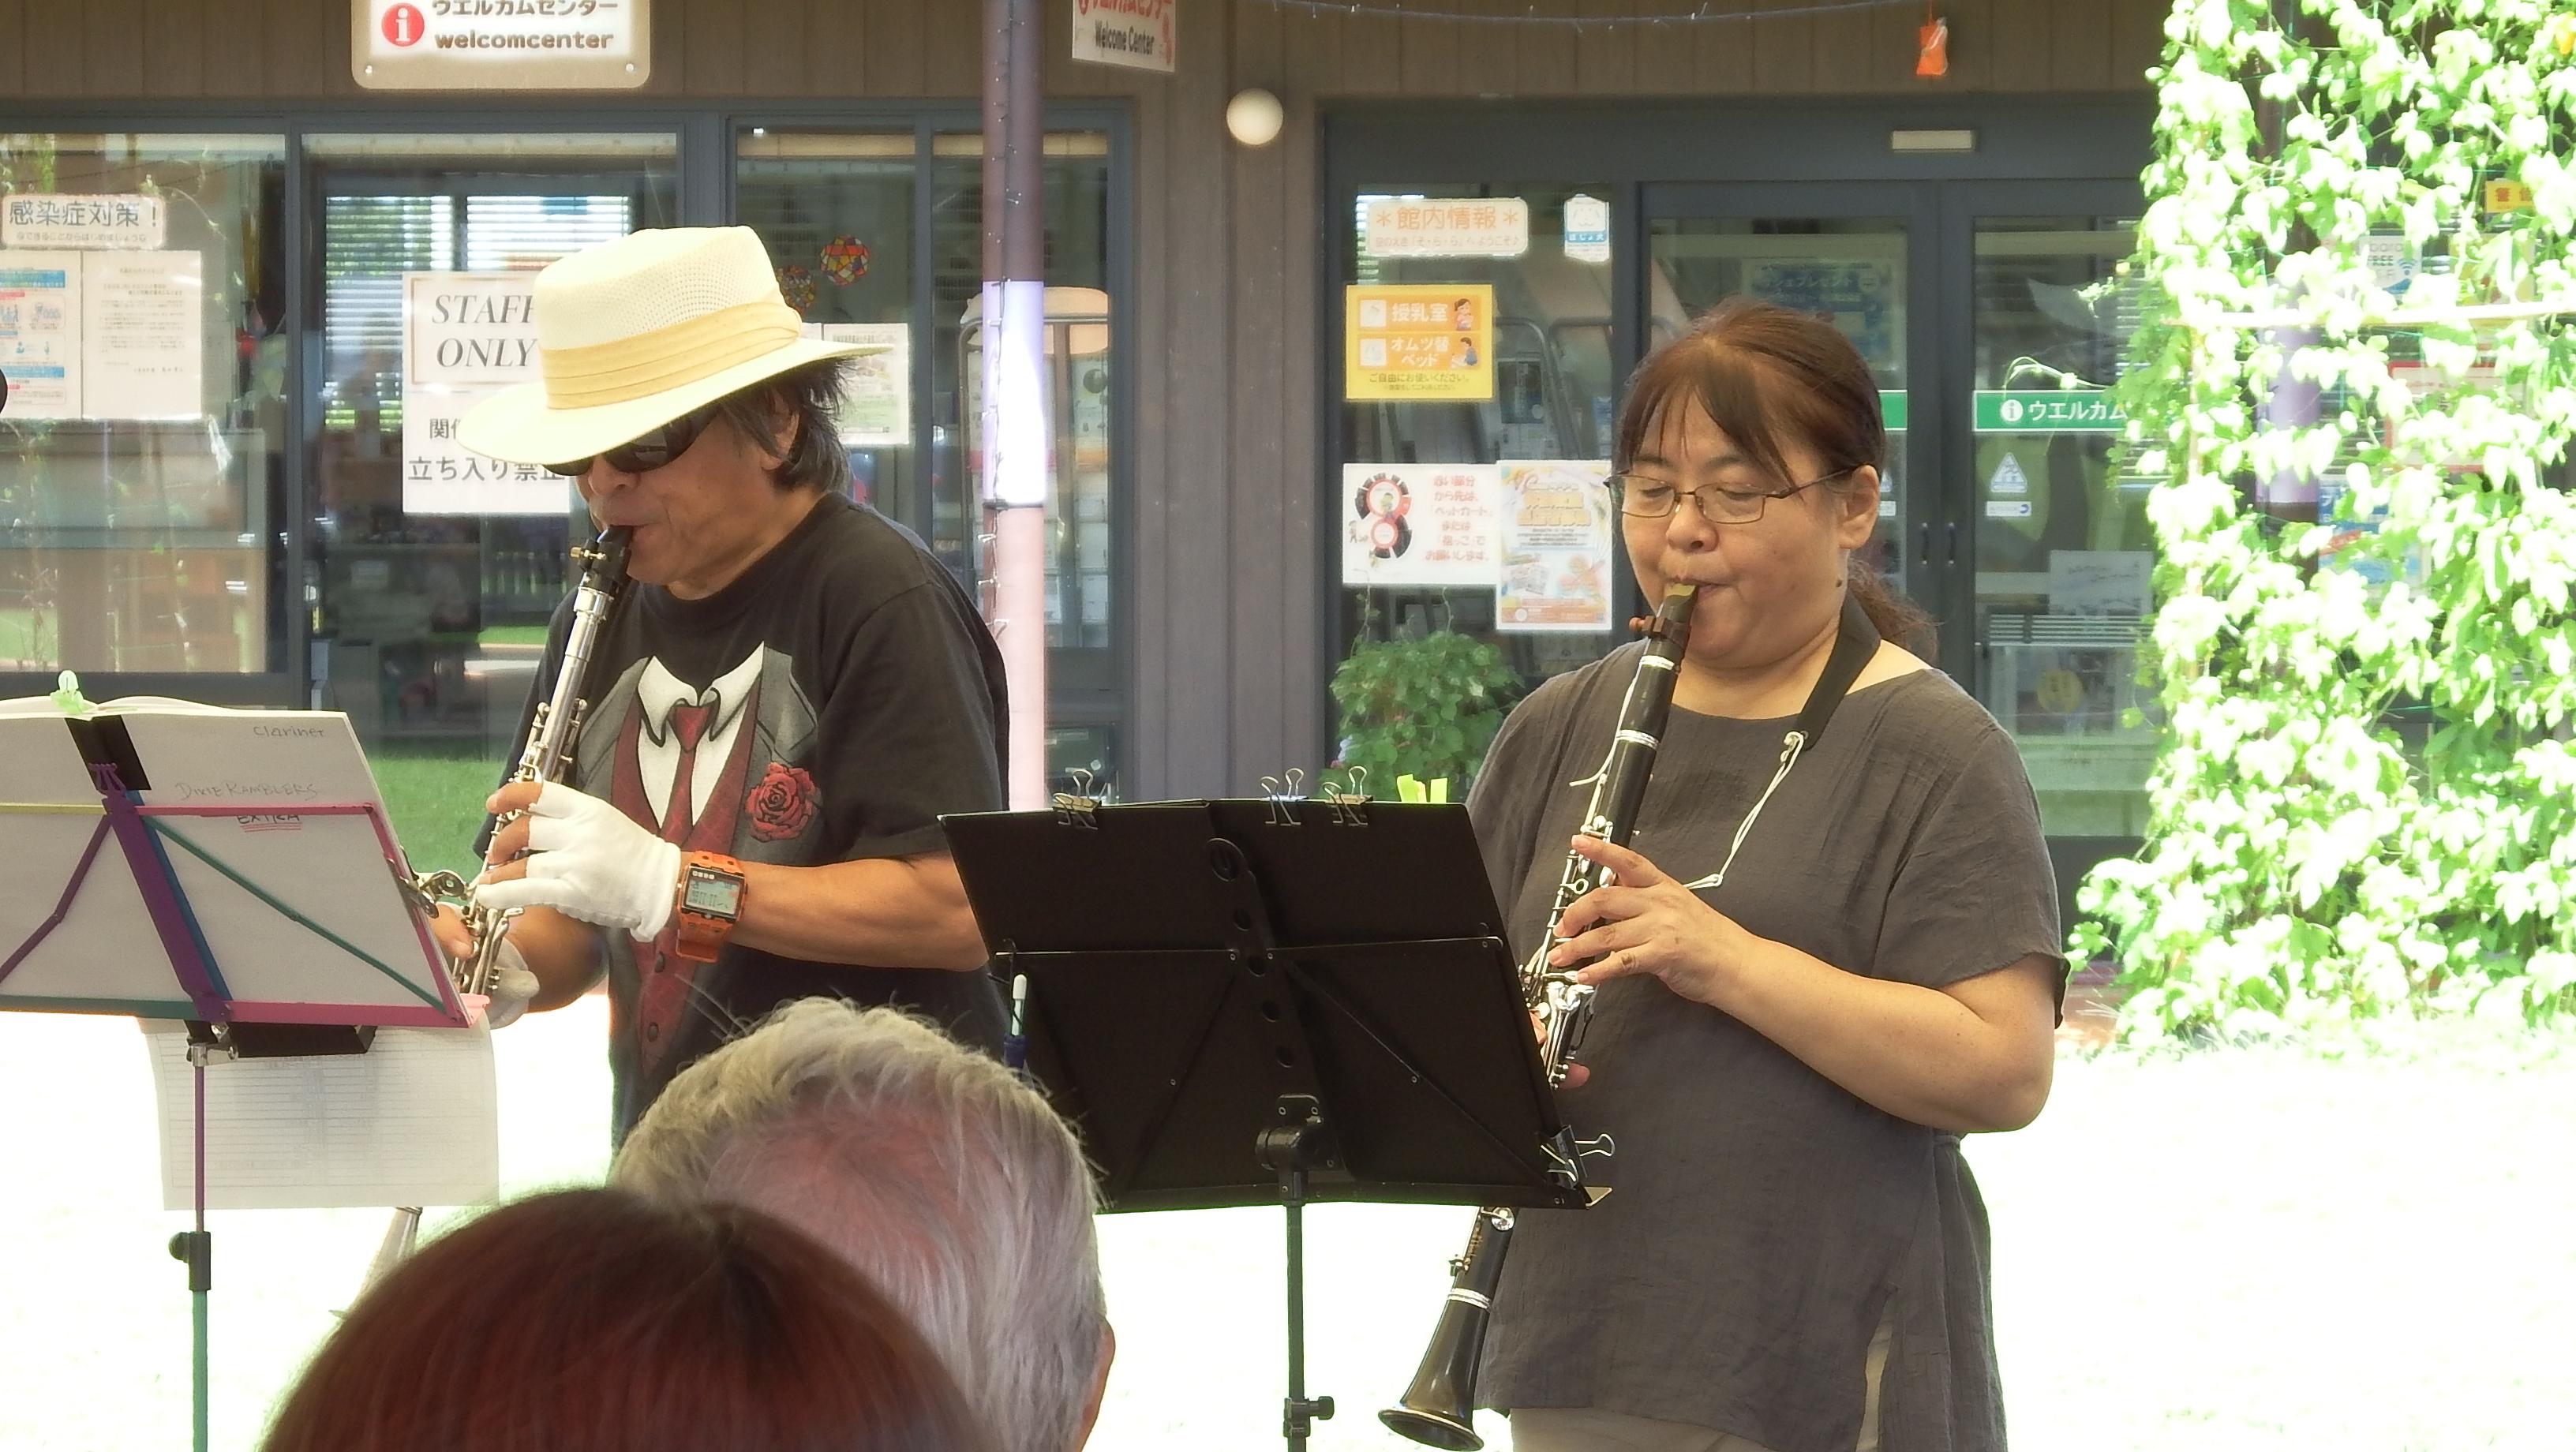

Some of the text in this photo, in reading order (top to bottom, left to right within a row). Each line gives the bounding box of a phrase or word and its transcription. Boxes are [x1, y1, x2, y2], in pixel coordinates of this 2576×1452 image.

[435, 29, 615, 49] welcomcenter
[1094, 19, 1155, 55] Welcome Center
[9, 200, 157, 227] 感染症対策！
[1391, 302, 1448, 323] 授乳室
[436, 337, 538, 368] ONLY
[1391, 336, 1450, 353] オムツ替
[1401, 353, 1438, 368] ベッド
[253, 725, 325, 738] Clarinet
